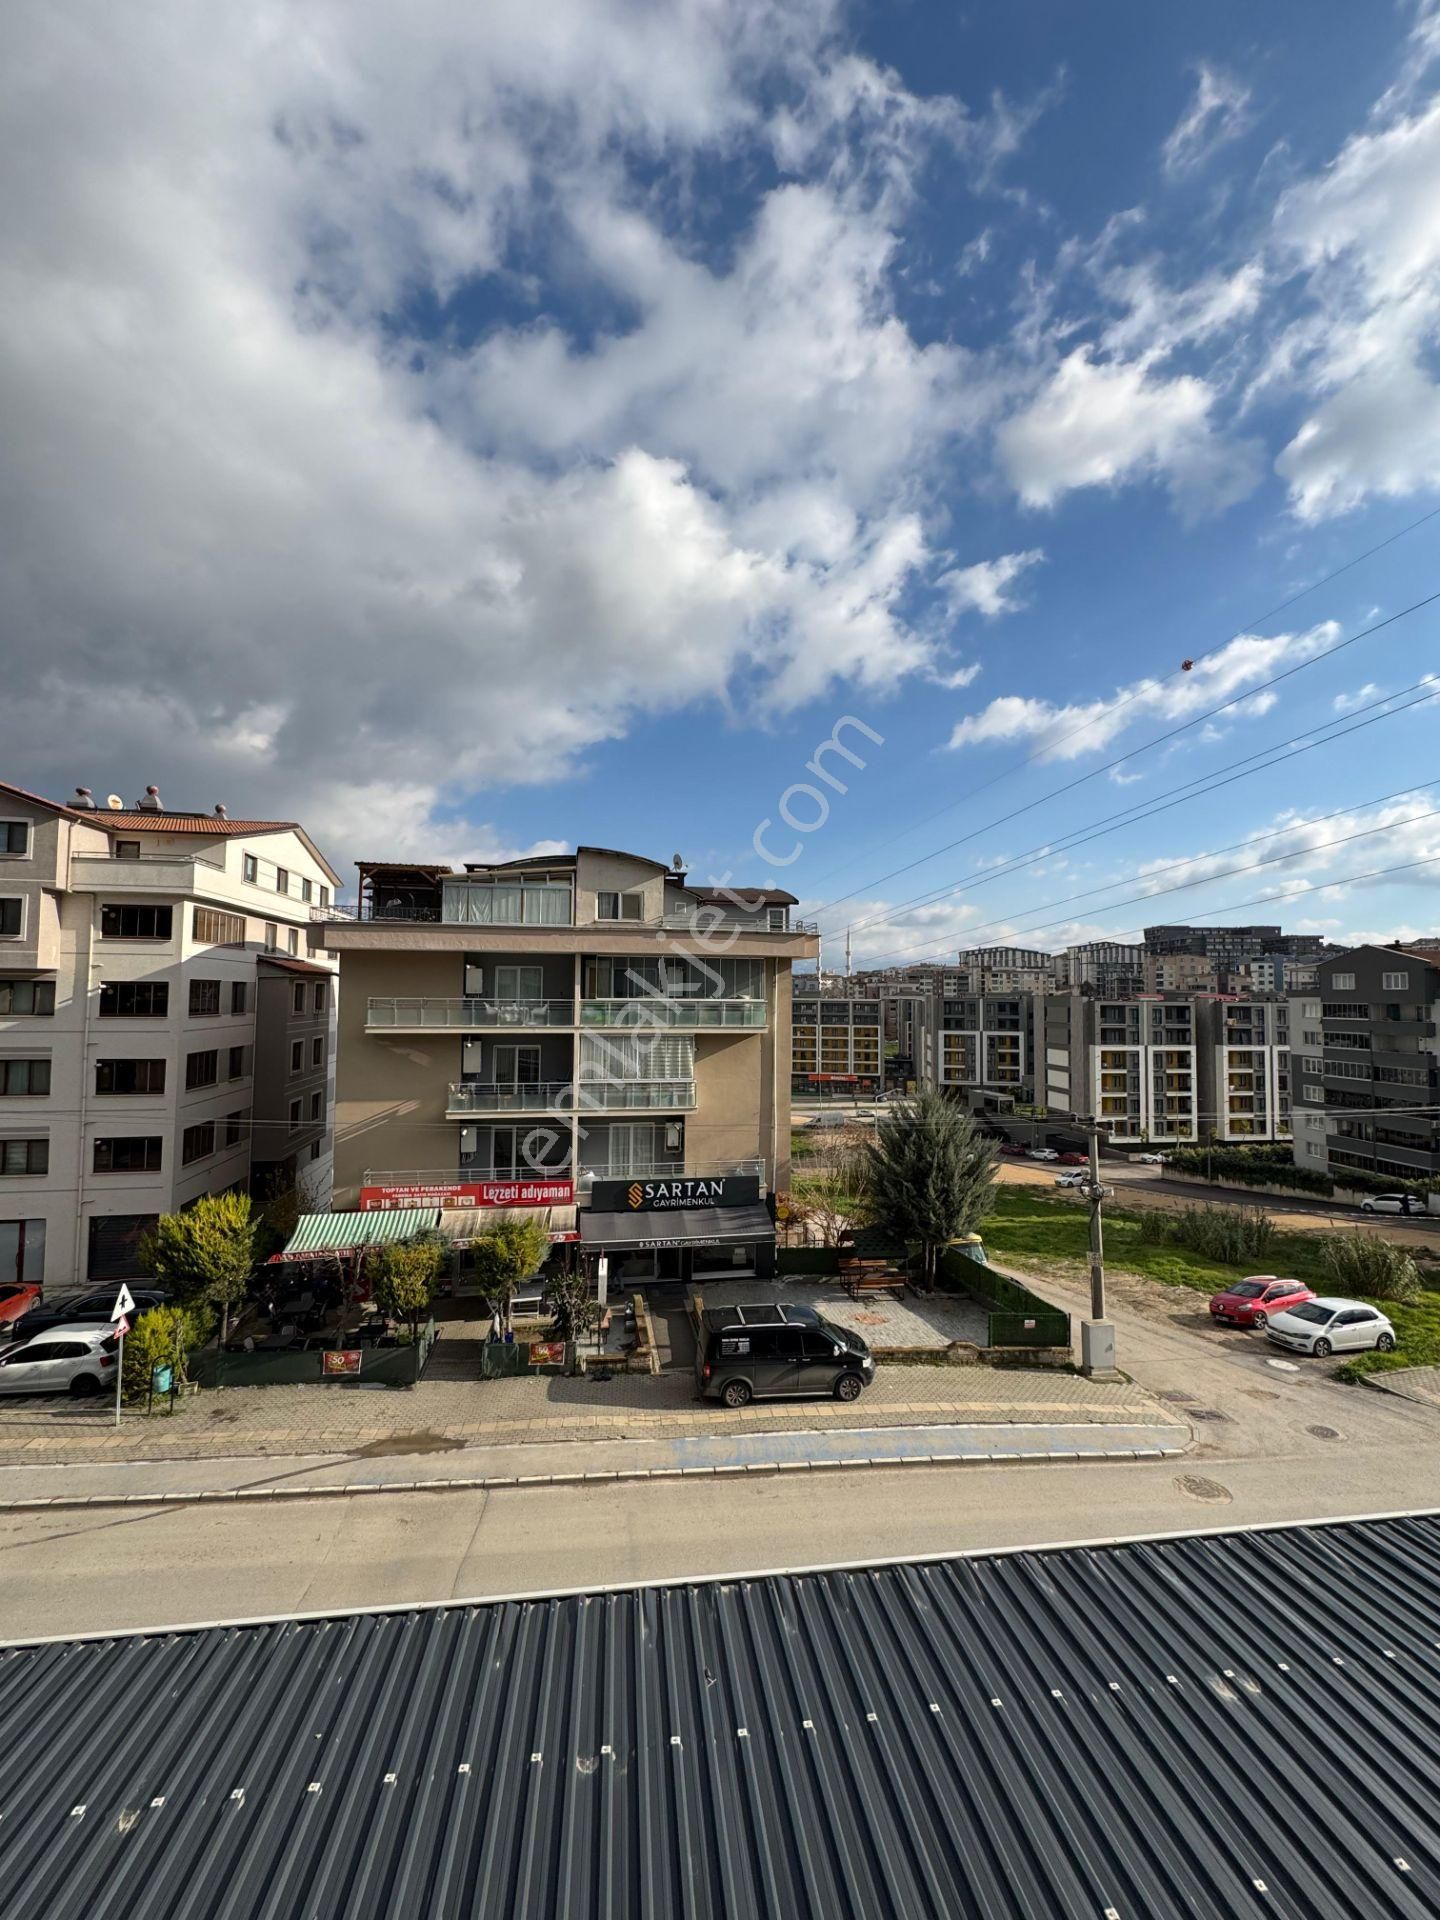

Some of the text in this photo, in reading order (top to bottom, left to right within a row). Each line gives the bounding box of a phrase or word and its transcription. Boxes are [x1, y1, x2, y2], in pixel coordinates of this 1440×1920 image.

[483, 1185, 519, 1204] Lezzeti
[645, 1181, 723, 1198] SARTAN
[653, 1197, 715, 1207] GAYRİMENKUL
